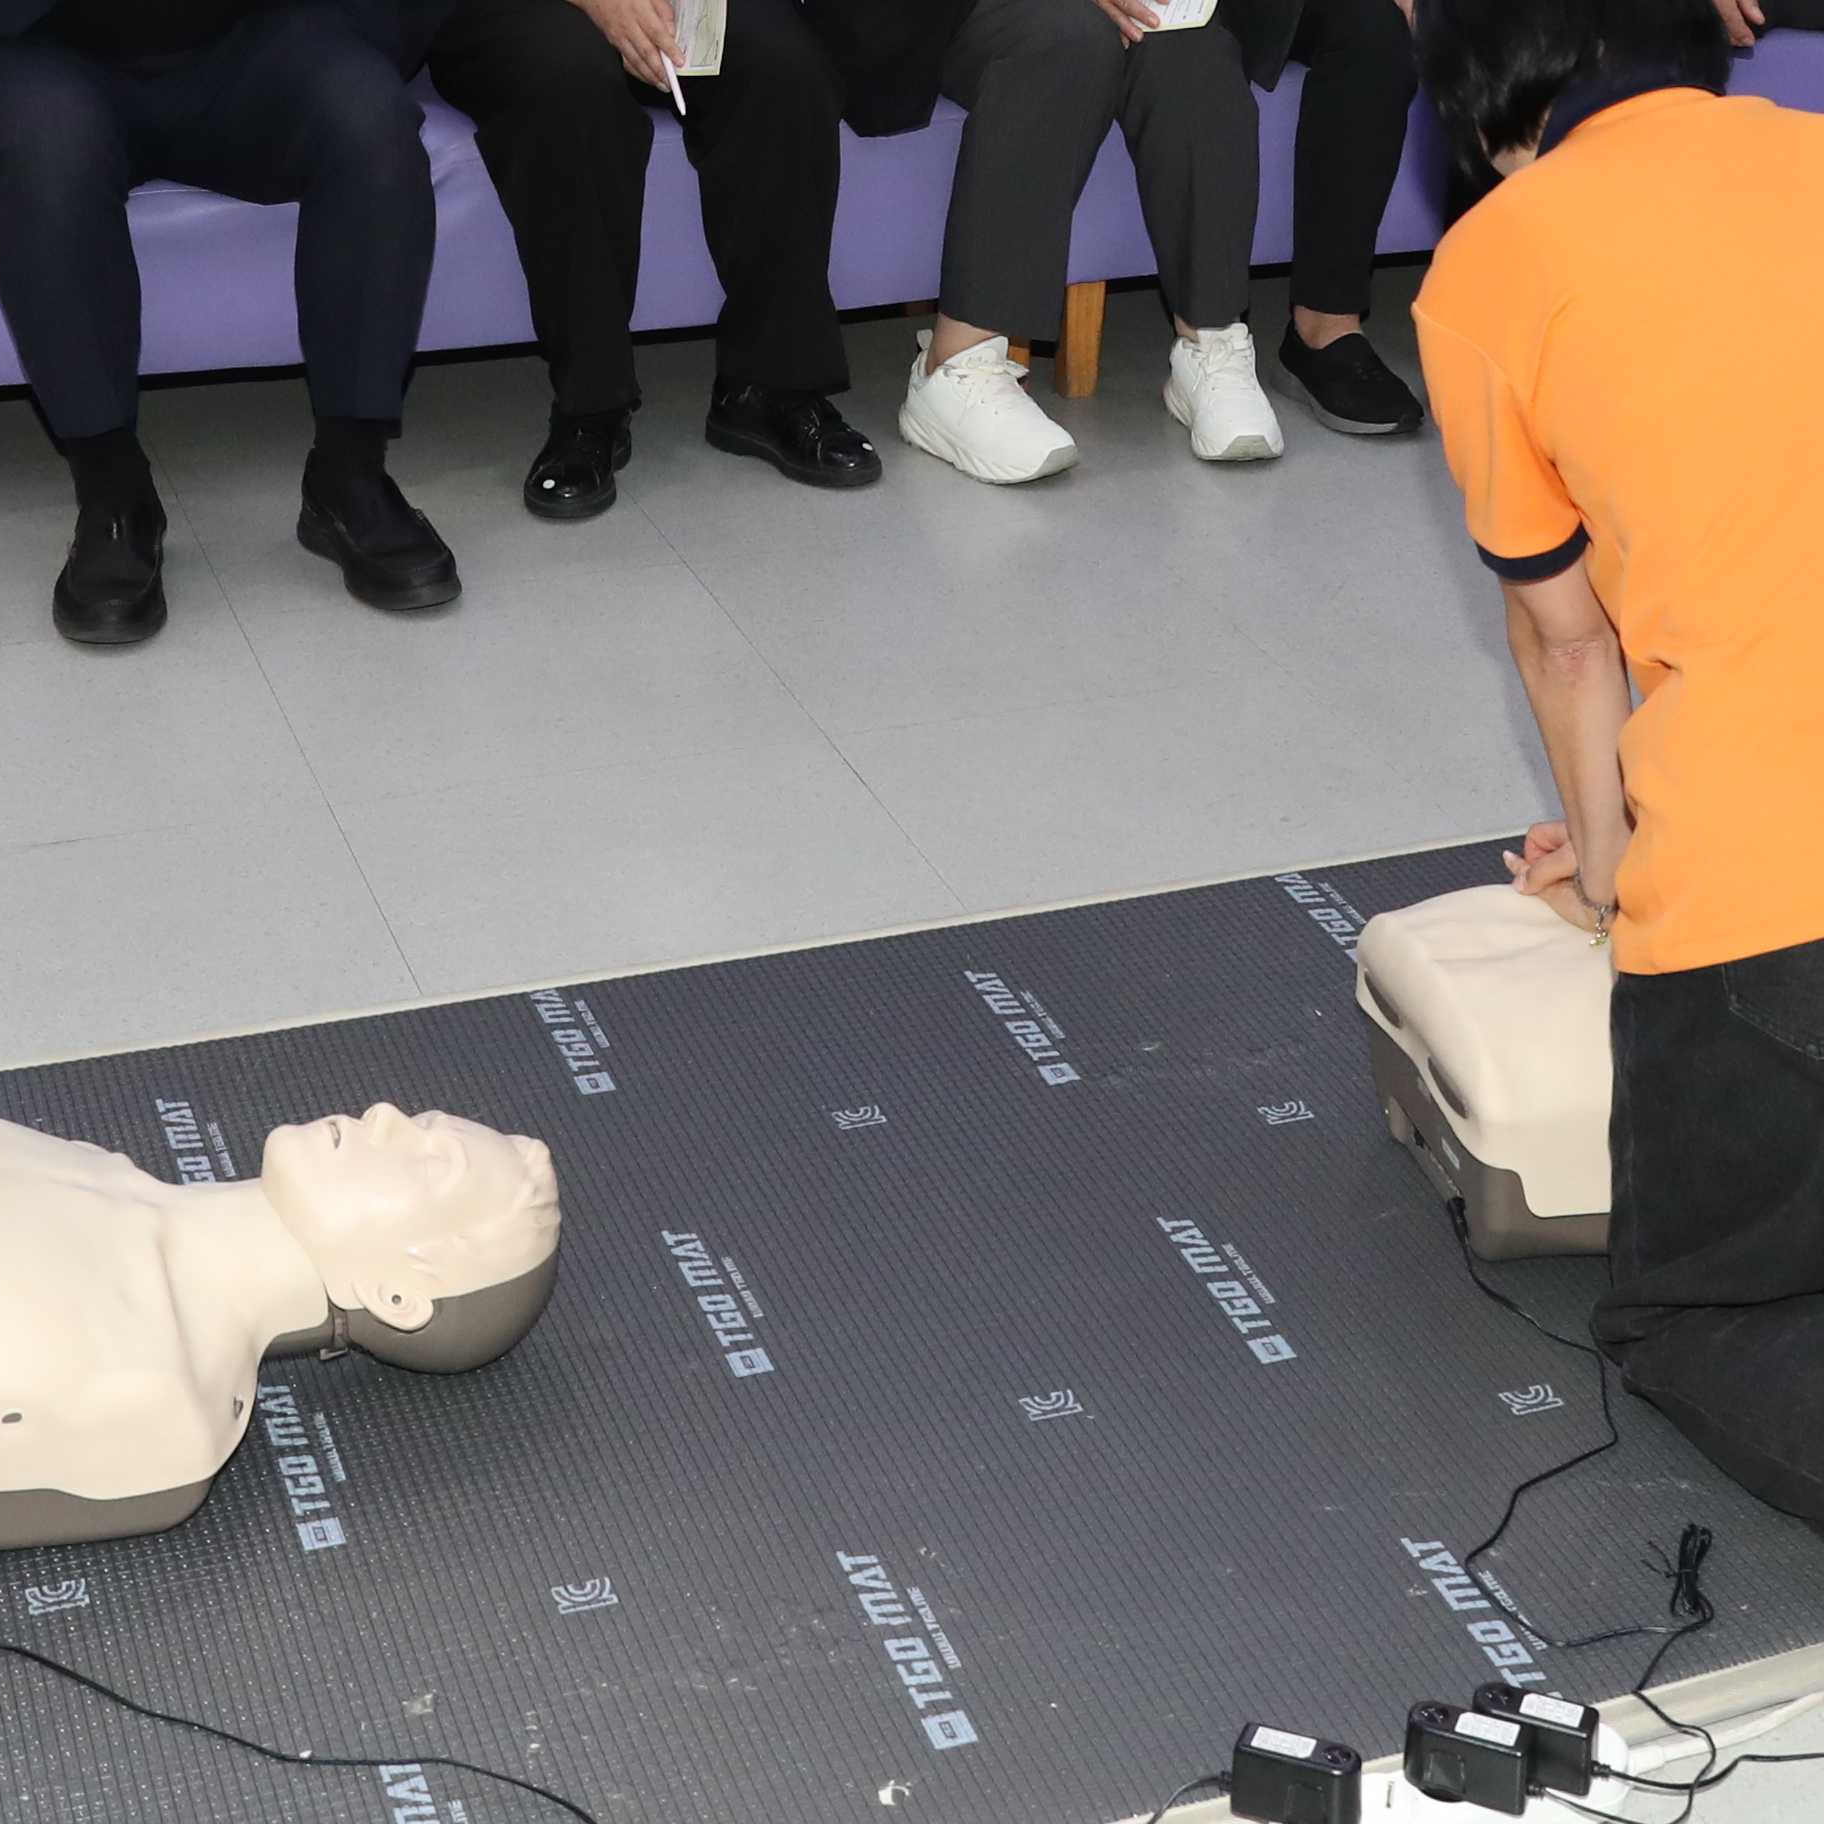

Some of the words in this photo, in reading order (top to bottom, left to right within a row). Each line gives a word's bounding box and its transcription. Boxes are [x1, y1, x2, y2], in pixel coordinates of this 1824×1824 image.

[964, 970, 1026, 1015] MAT
[1004, 1020, 1061, 1061] TGO
[156, 1099, 204, 1149] MAT
[662, 1230, 724, 1287] MAT
[1156, 1217, 1230, 1274] MAT
[697, 1294, 753, 1347] TGO
[1207, 1281, 1272, 1334] TGO
[258, 1385, 309, 1446] MAT
[279, 1456, 331, 1516] TGO
[836, 1551, 912, 1625] MAT
[1399, 1537, 1493, 1611] MAT
[883, 1637, 953, 1708] TGO
[1466, 1620, 1547, 1689] TGO
